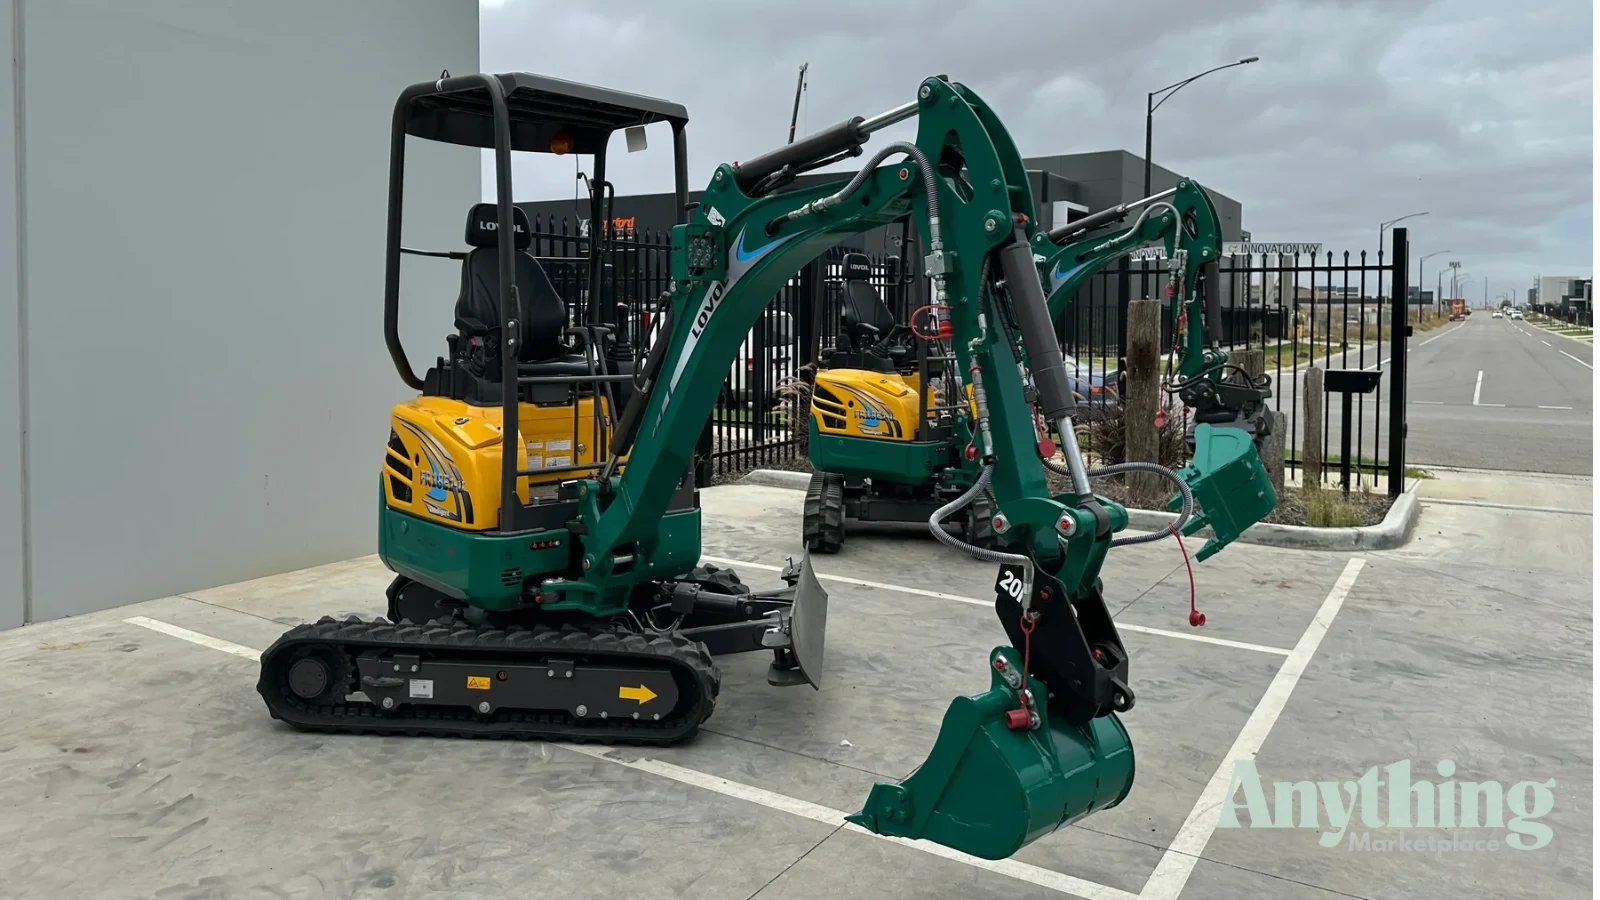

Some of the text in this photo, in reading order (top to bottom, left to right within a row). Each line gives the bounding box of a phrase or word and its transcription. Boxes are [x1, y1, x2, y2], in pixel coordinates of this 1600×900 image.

[1241, 243, 1320, 254] INNOVATION WY
[850, 263, 870, 271] LOVOL
[691, 279, 730, 339] LOVOL
